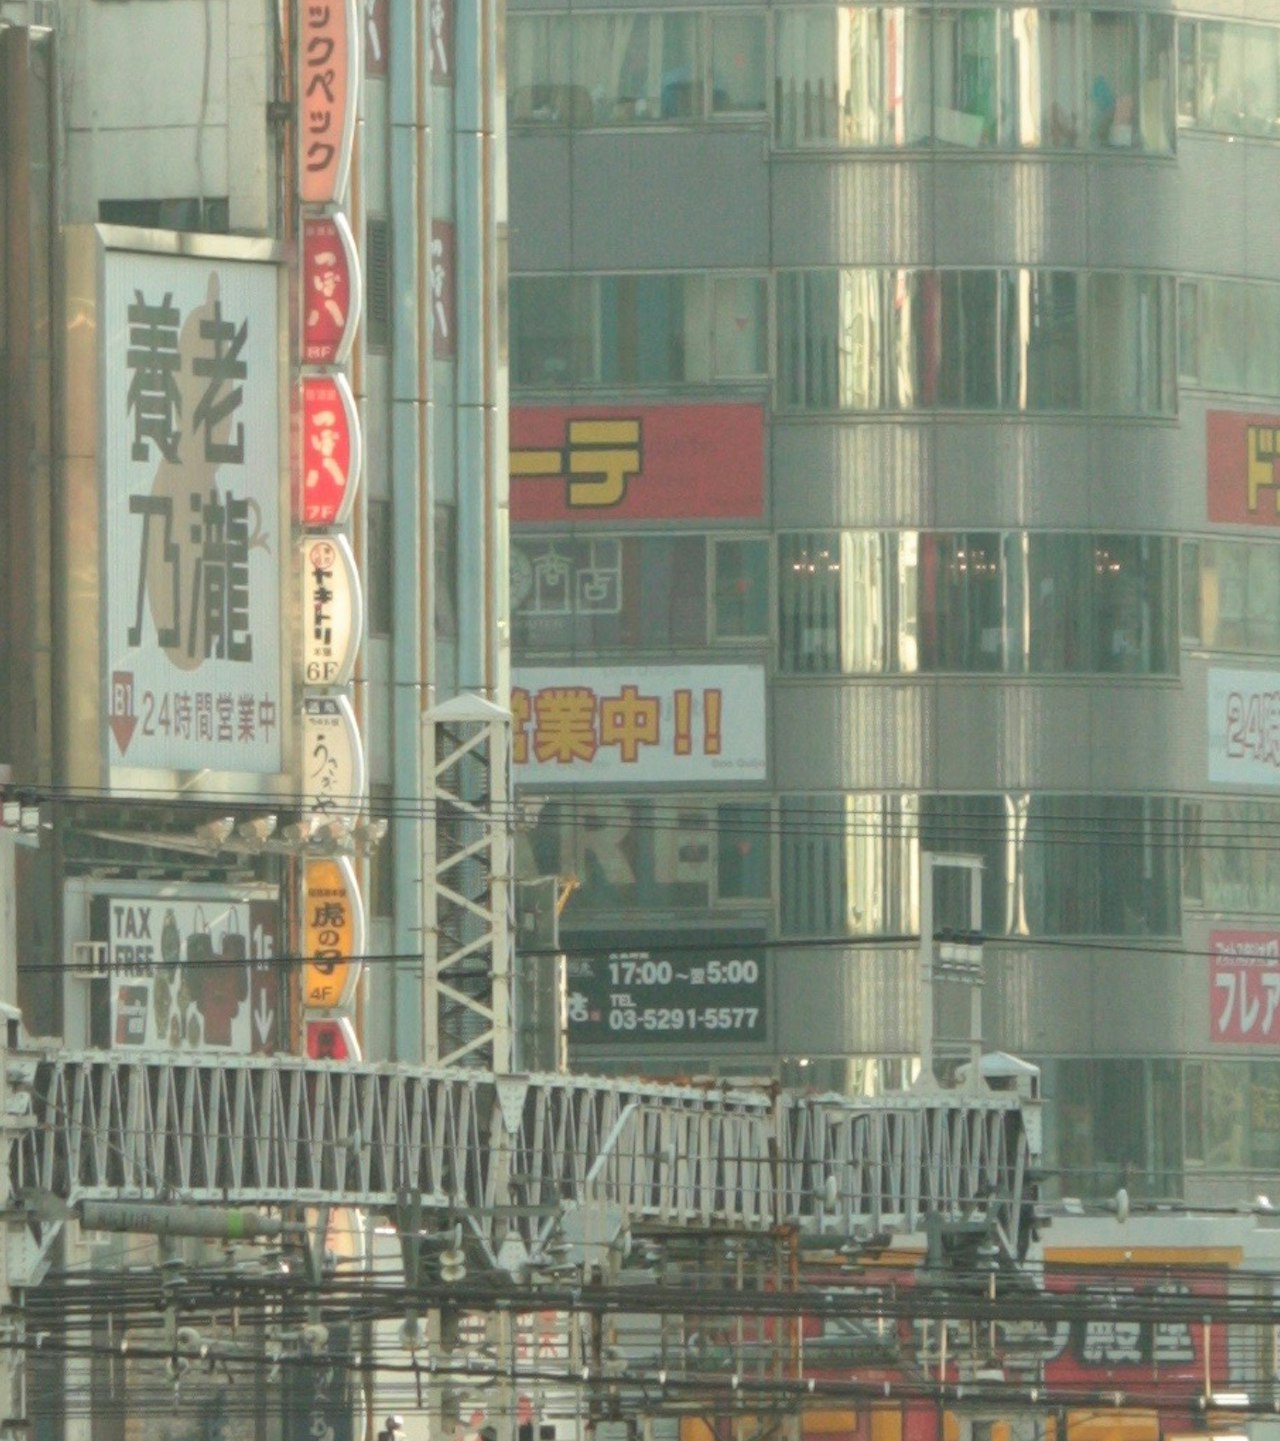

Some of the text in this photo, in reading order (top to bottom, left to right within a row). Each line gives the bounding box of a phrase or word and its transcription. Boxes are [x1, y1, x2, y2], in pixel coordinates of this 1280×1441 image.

[306, 664, 337, 681] 6F
[141, 690, 277, 744] 24時間営業中
[114, 906, 151, 940] TAX
[310, 985, 332, 1001] 4F
[609, 992, 637, 1008] TEL
[608, 1008, 759, 1030] 03-5291-5577
